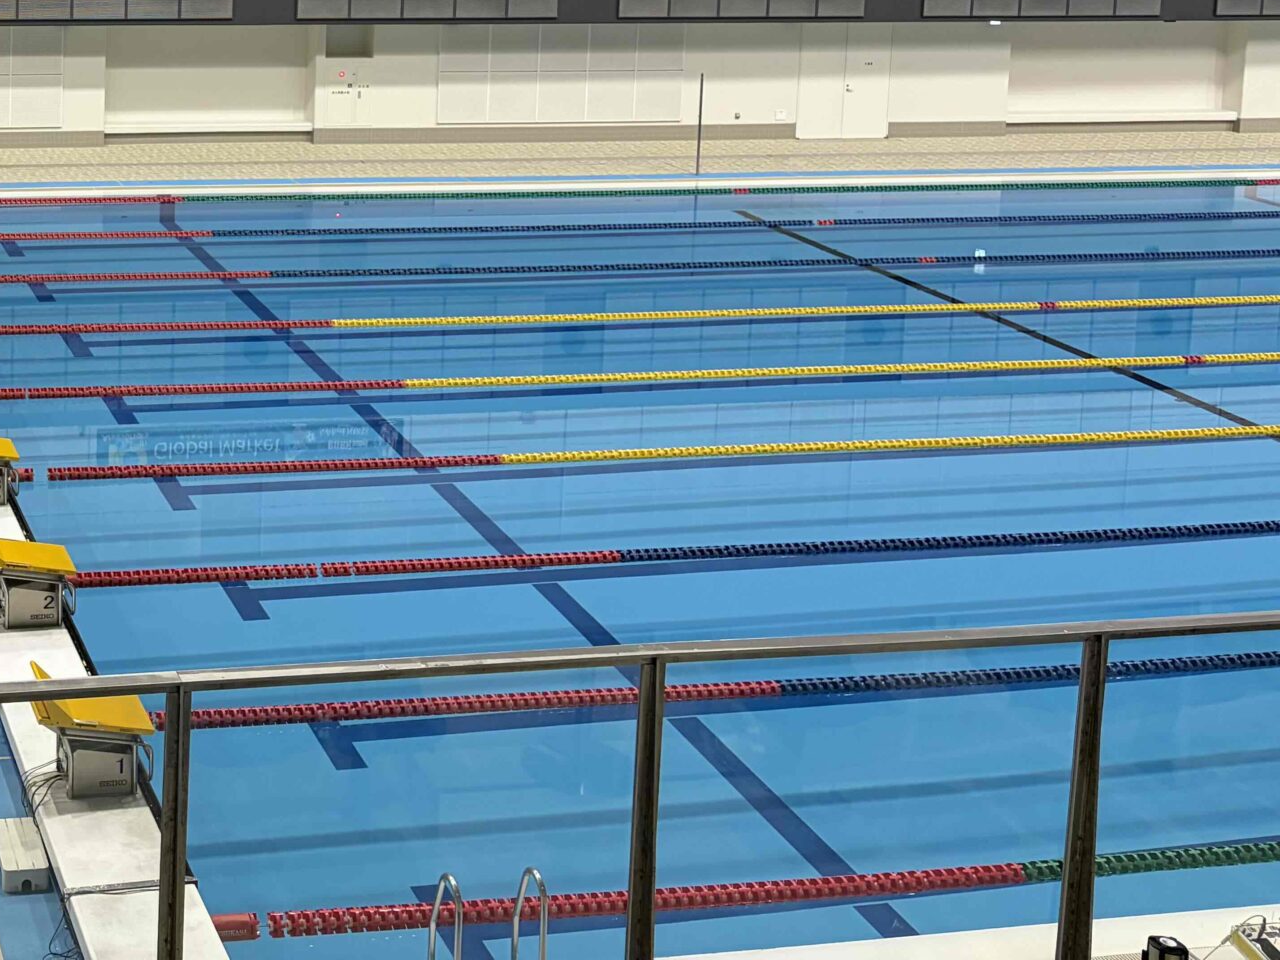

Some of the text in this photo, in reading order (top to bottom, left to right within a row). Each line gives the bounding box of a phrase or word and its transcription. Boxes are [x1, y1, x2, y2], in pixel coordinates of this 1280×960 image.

[43, 594, 55, 610] 2
[115, 757, 124, 775] 1
[98, 779, 128, 788] SEIKO
